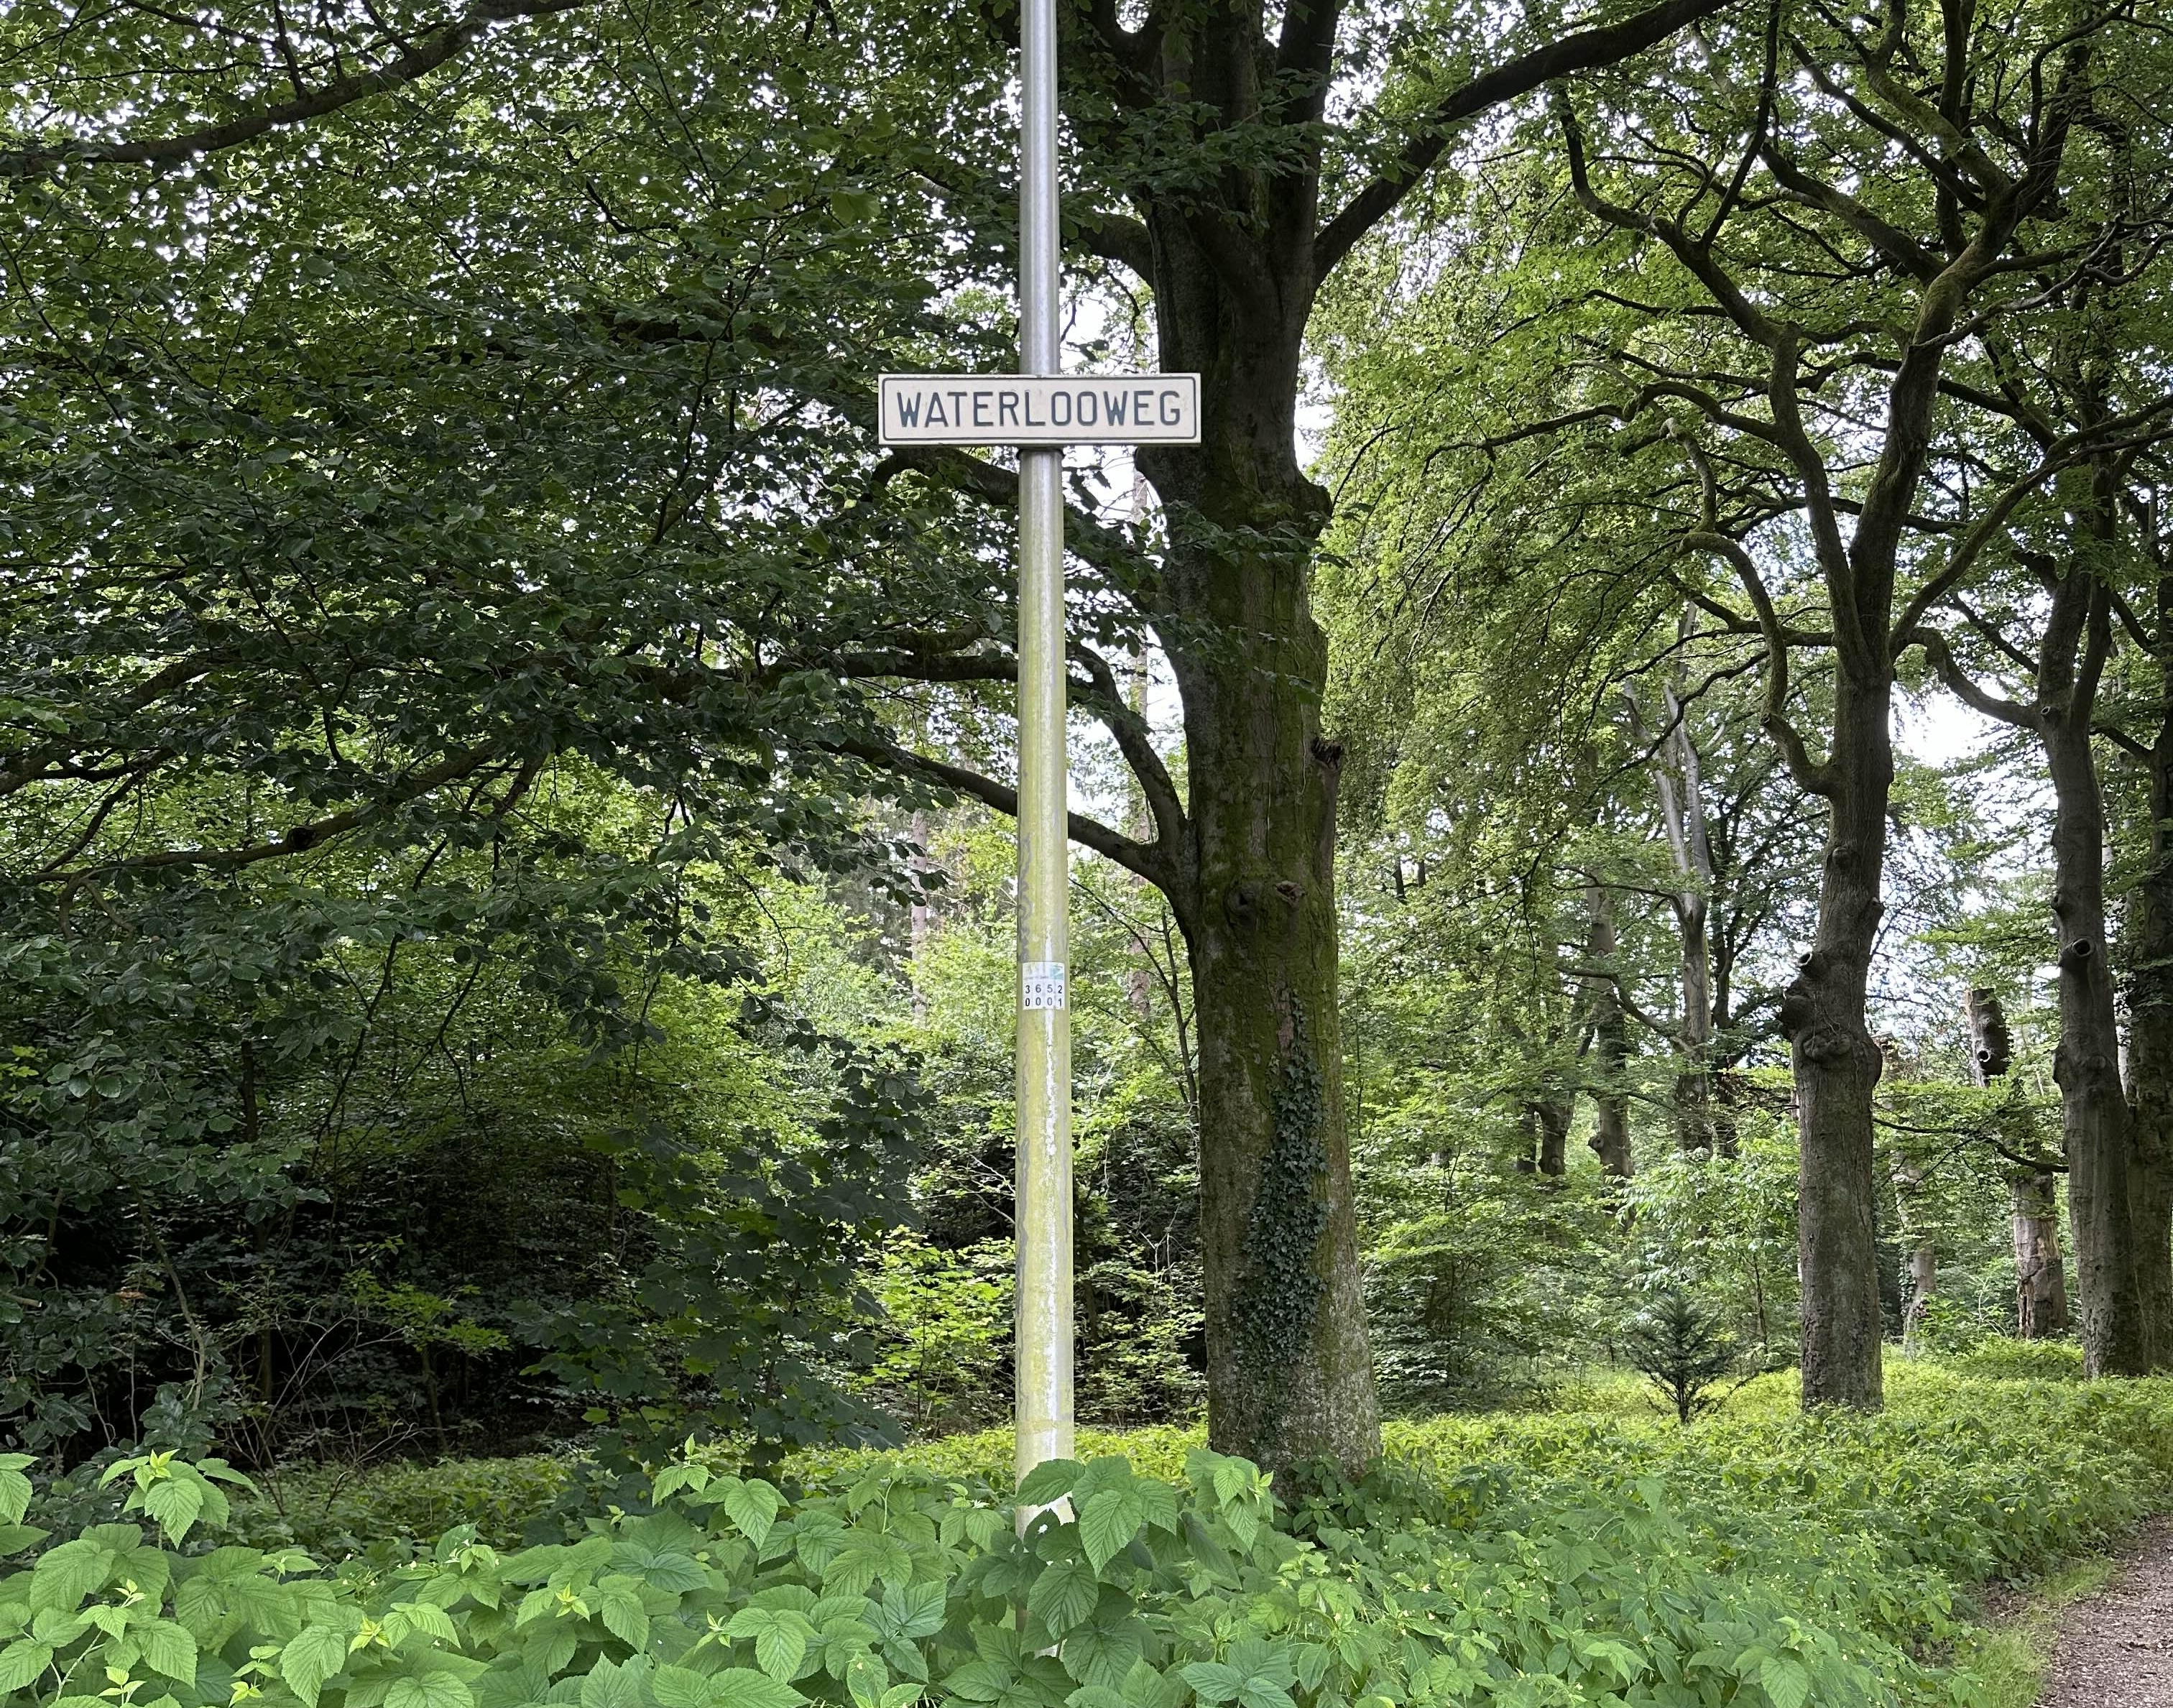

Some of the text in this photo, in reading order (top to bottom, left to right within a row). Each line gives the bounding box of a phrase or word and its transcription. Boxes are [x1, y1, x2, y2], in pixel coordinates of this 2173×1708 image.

[896, 390, 1180, 428] WATERLOOWEG
[1025, 984, 1063, 994] 3652
[1025, 997, 1062, 1007] 0001
